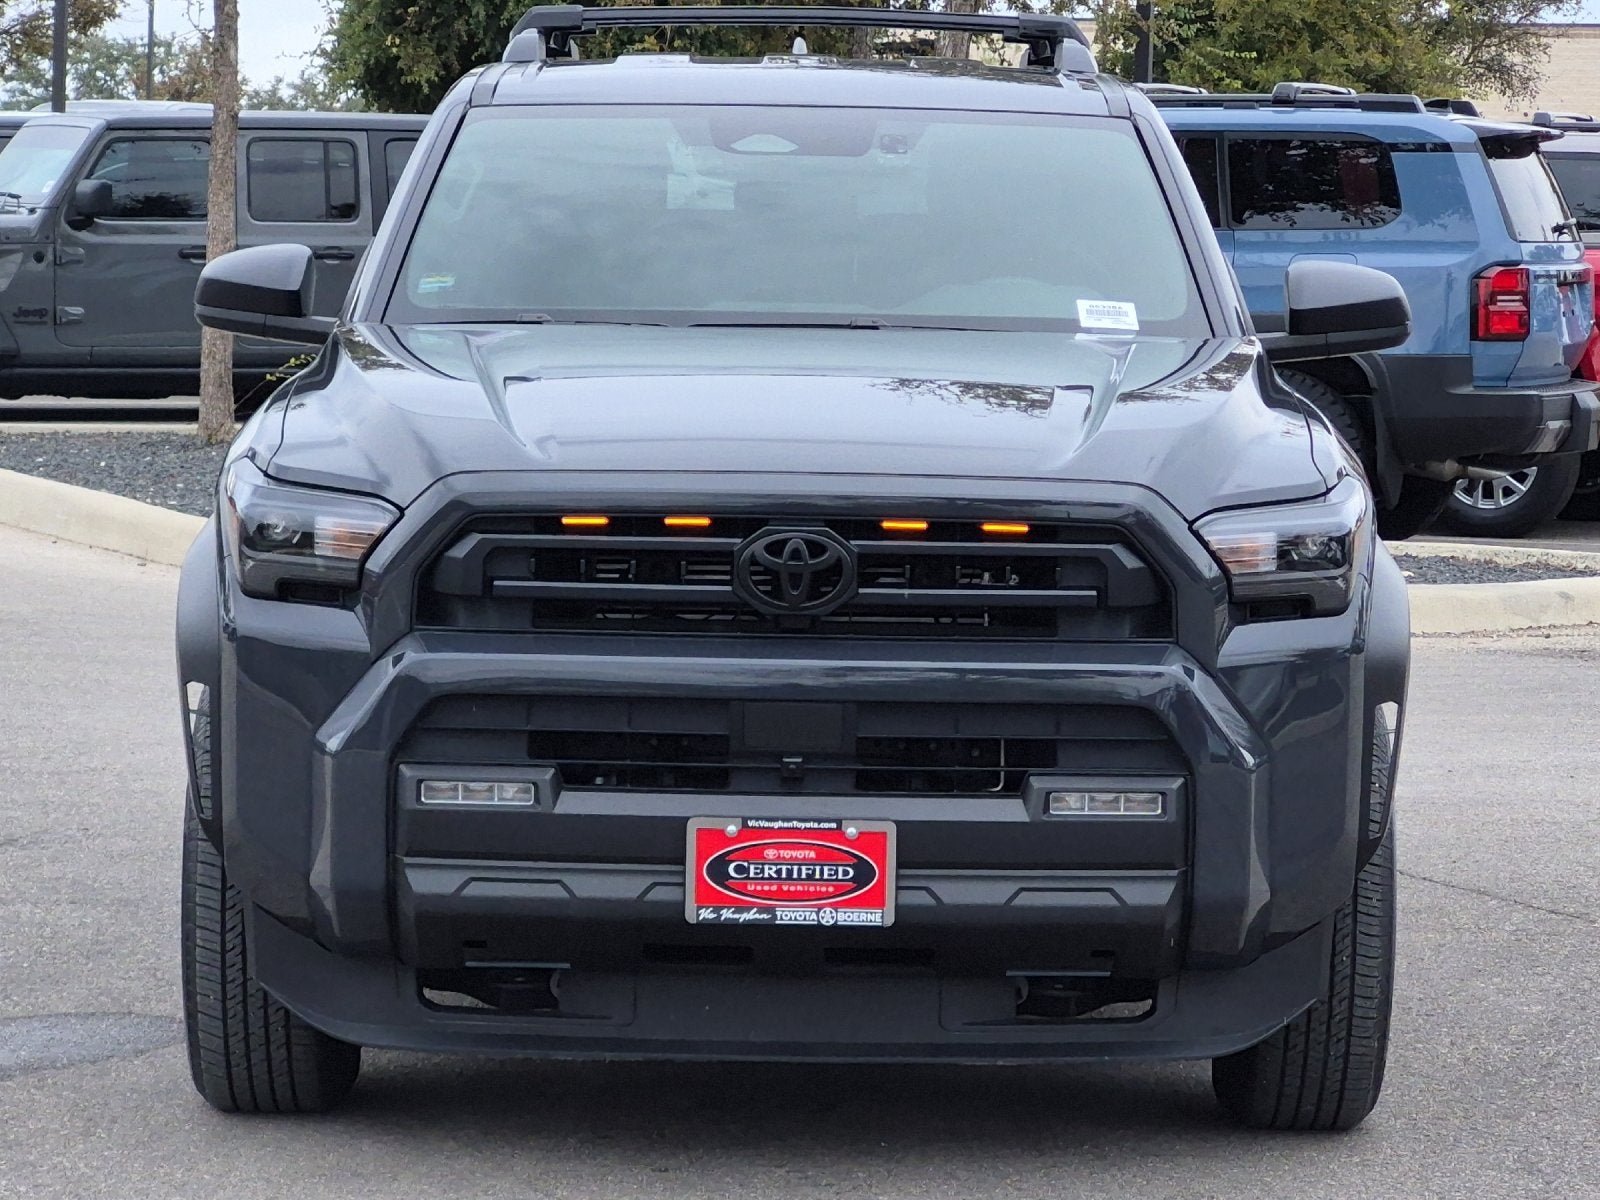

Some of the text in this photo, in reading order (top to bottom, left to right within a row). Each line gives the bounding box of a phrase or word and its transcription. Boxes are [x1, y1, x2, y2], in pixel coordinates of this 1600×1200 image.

[12, 306, 48, 319] Jeep
[747, 819, 837, 830] VicVaughanToyota.com
[778, 849, 816, 858] TOYOTA
[727, 861, 854, 880] CERTIFIED
[746, 883, 835, 892] Used Vehicles
[698, 907, 883, 923] Vic Vaughan TOYOTA BOERNE
